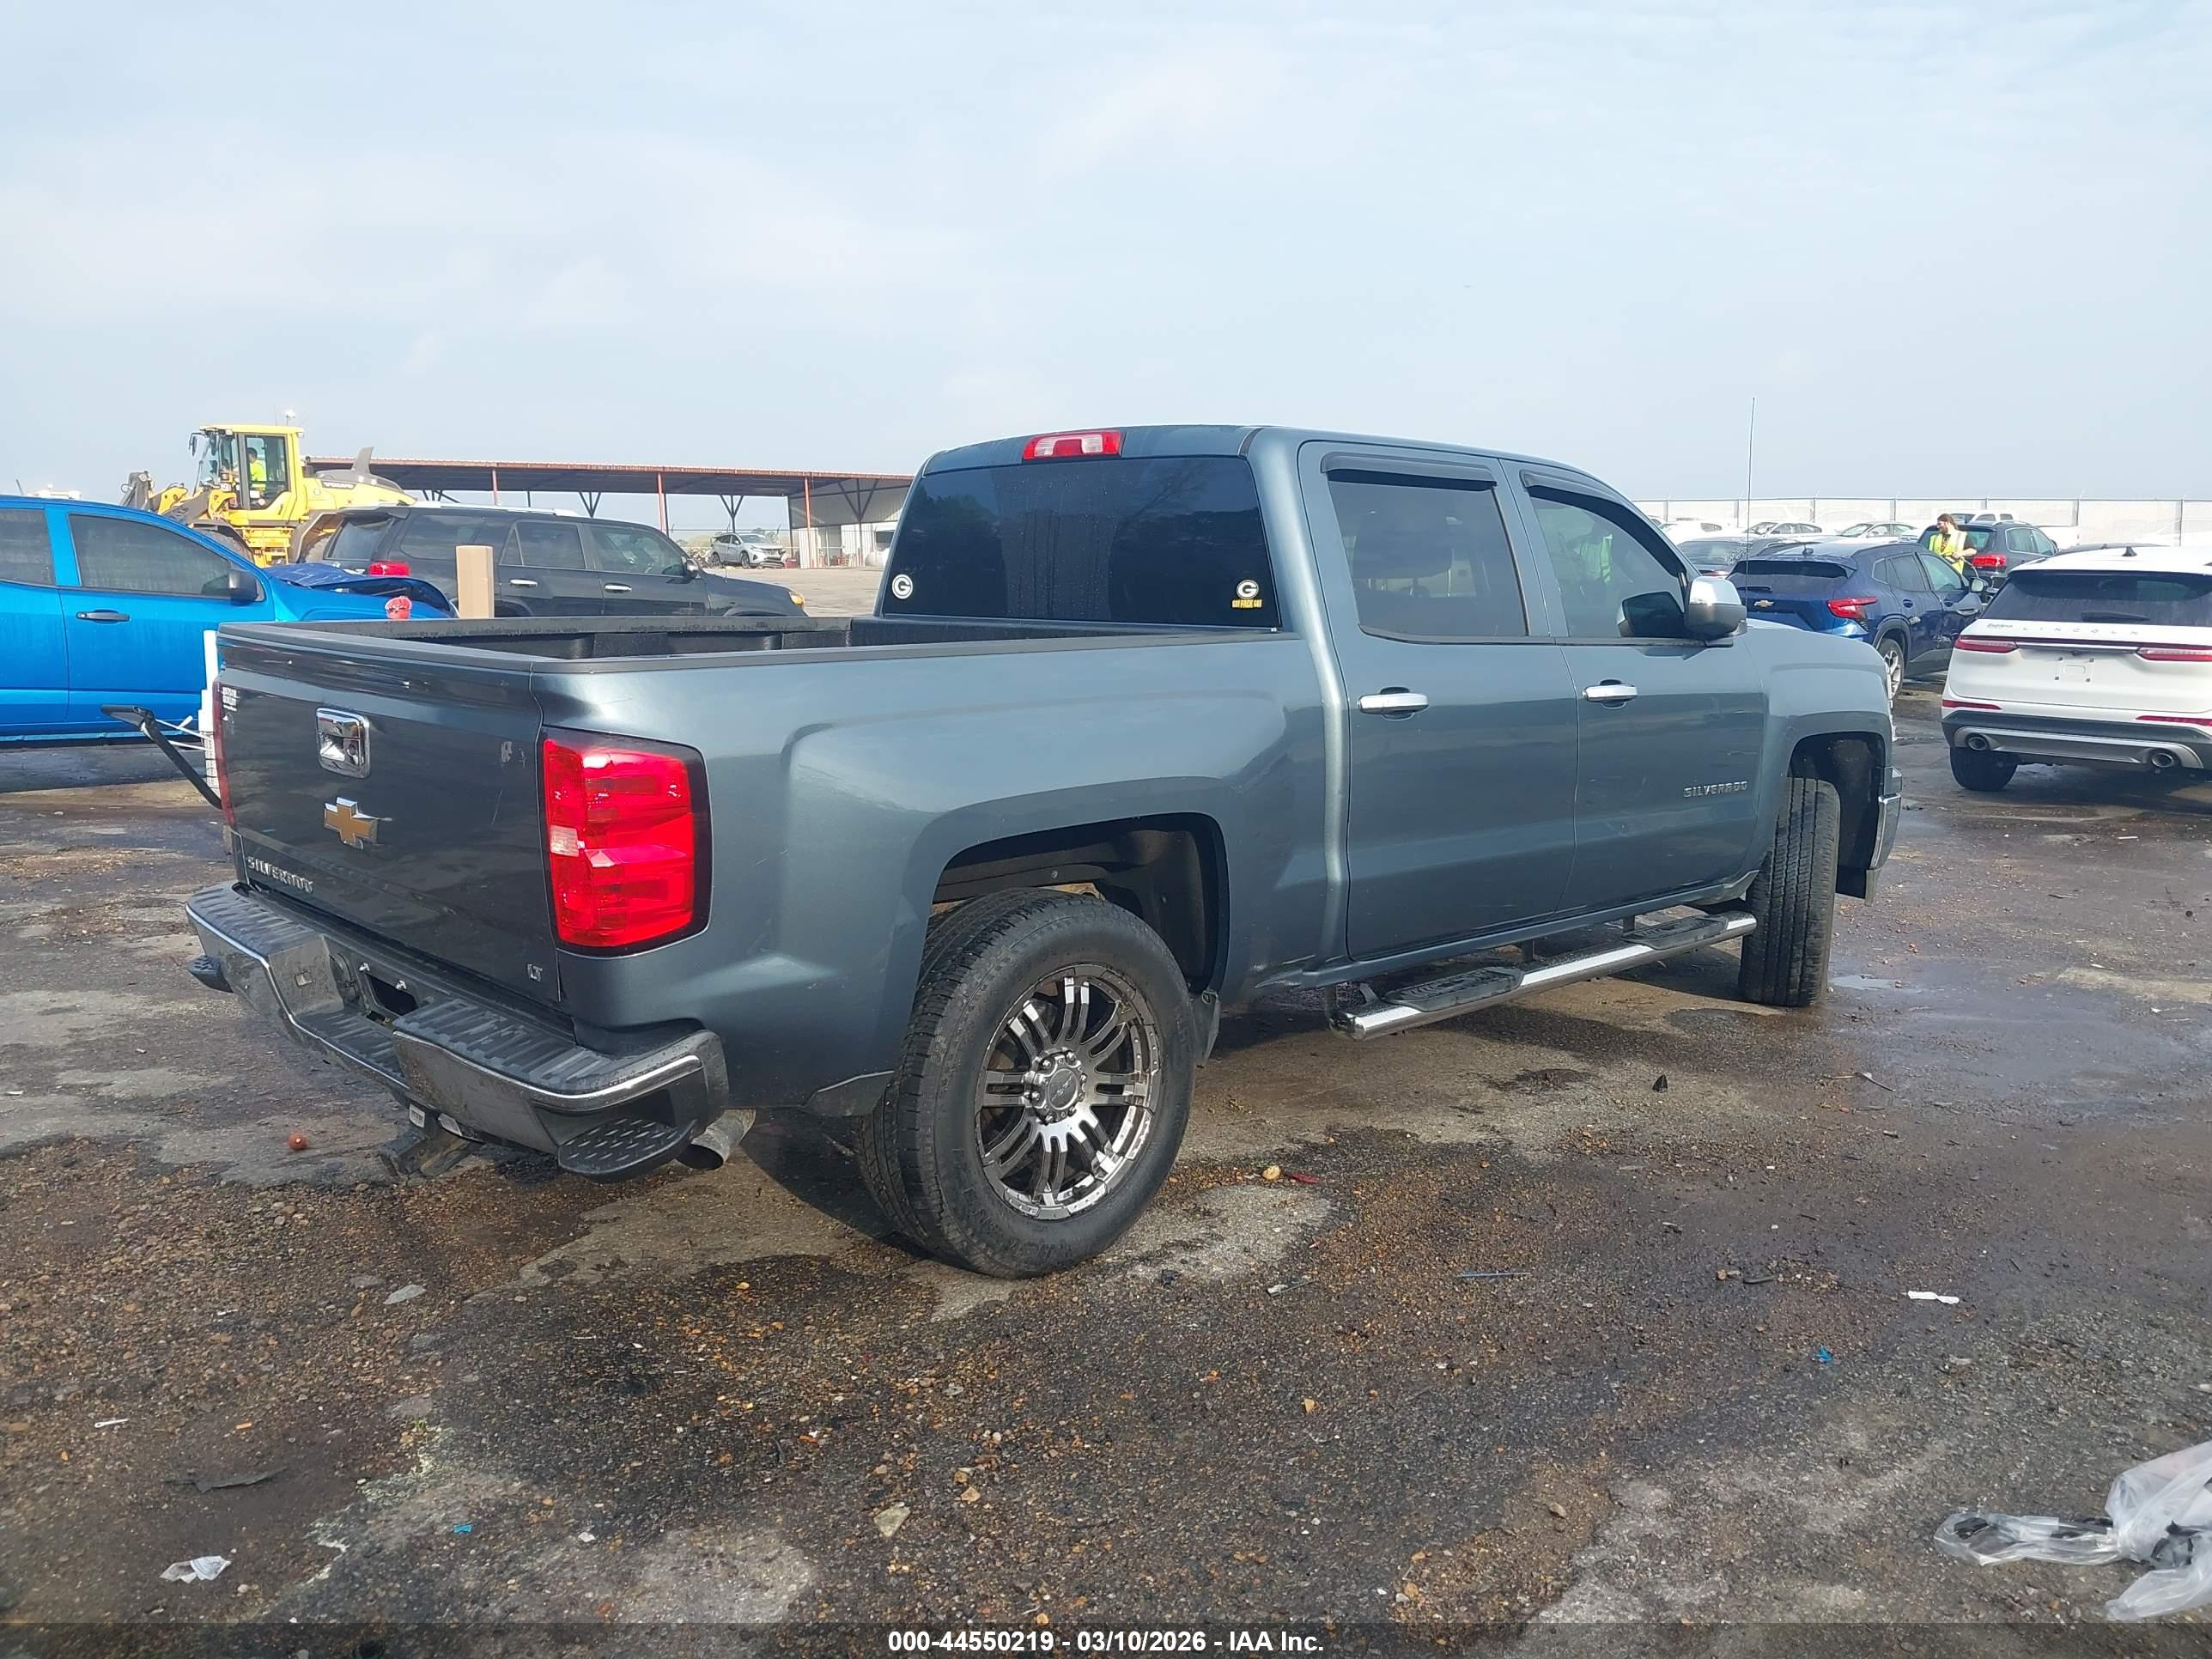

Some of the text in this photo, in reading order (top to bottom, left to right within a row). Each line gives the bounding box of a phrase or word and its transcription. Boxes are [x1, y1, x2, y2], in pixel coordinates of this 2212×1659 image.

[1683, 781, 1747, 798] SILVERADO
[247, 856, 313, 893] SILVERADO
[527, 963, 543, 981] LT
